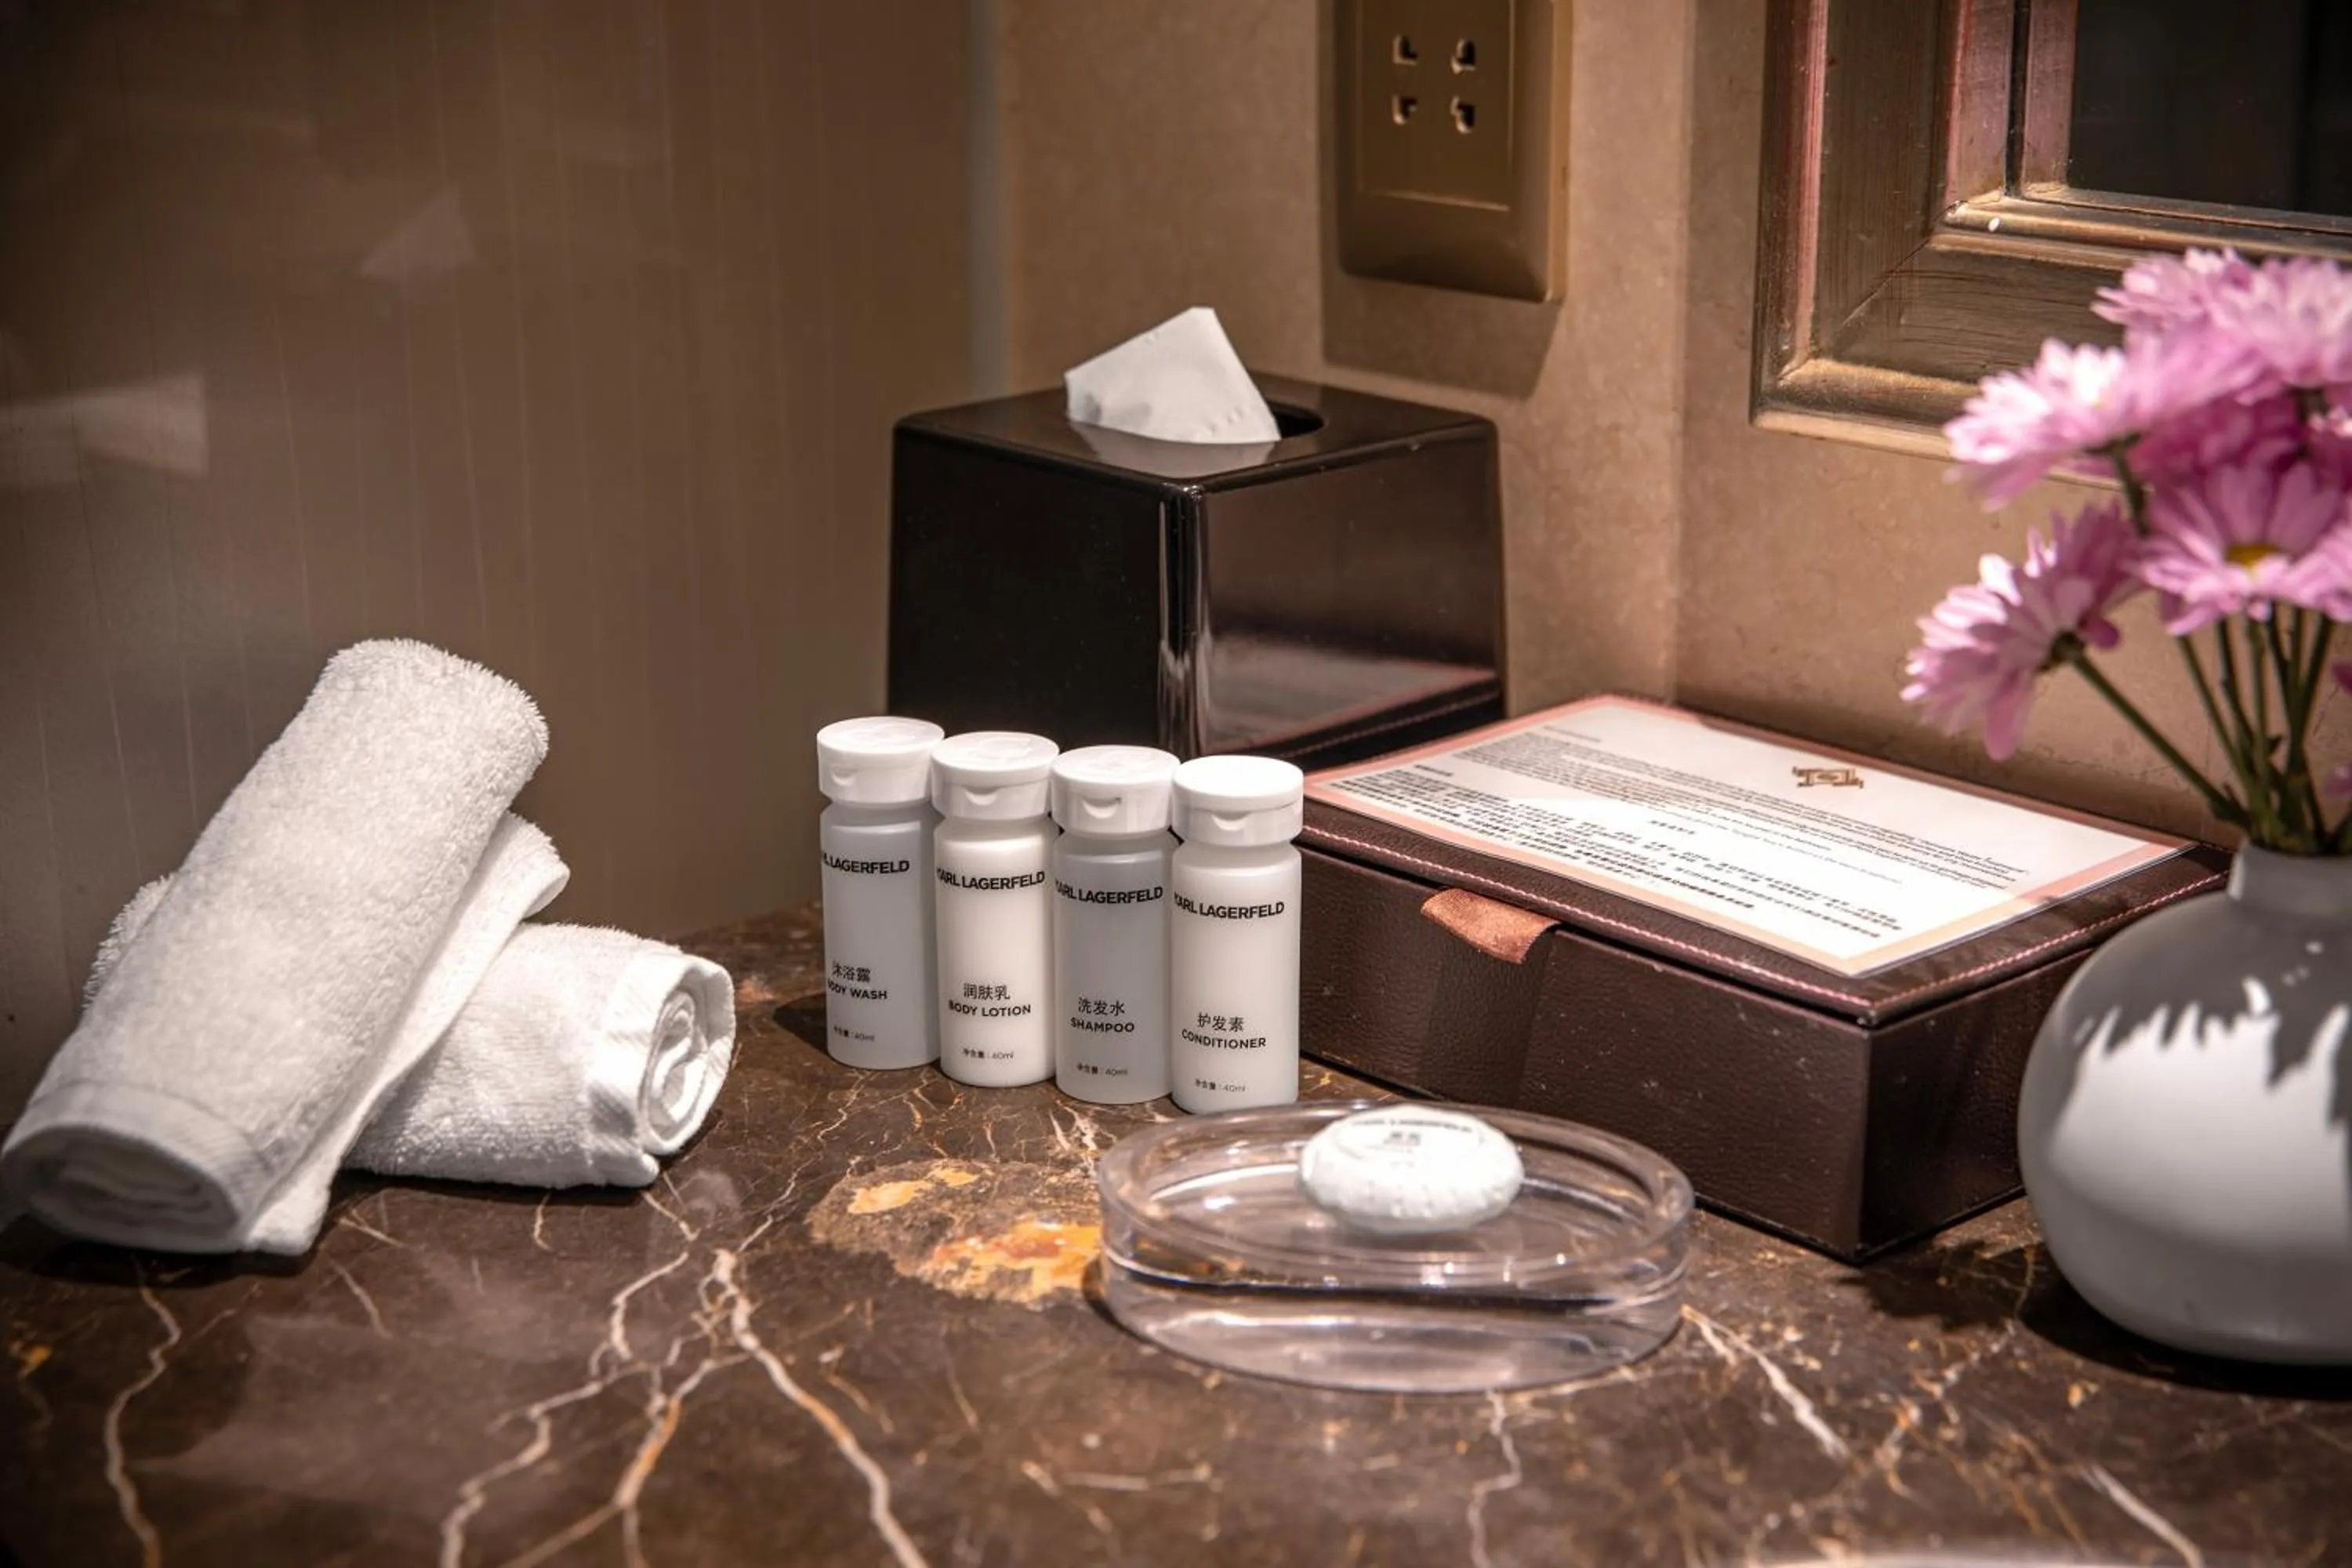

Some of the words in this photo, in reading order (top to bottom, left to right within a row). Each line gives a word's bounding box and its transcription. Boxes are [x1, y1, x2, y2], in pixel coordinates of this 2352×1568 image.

[829, 855, 910, 874] LAGERFELD
[961, 870, 1045, 890] LAGERFELD
[1078, 885, 1163, 904] LAGERFELD
[1199, 901, 1285, 919] LAGERFELD
[850, 987, 888, 1000] WASH
[963, 982, 1011, 1000] 润肤乳
[949, 1000, 978, 1015] BODY
[982, 1004, 1031, 1017] LOTION
[1078, 996, 1125, 1017] 洗发水
[1070, 1017, 1134, 1033] SHAMPOO
[1196, 1012, 1244, 1032] 护发素
[1181, 1028, 1266, 1049] CONDITIONER
